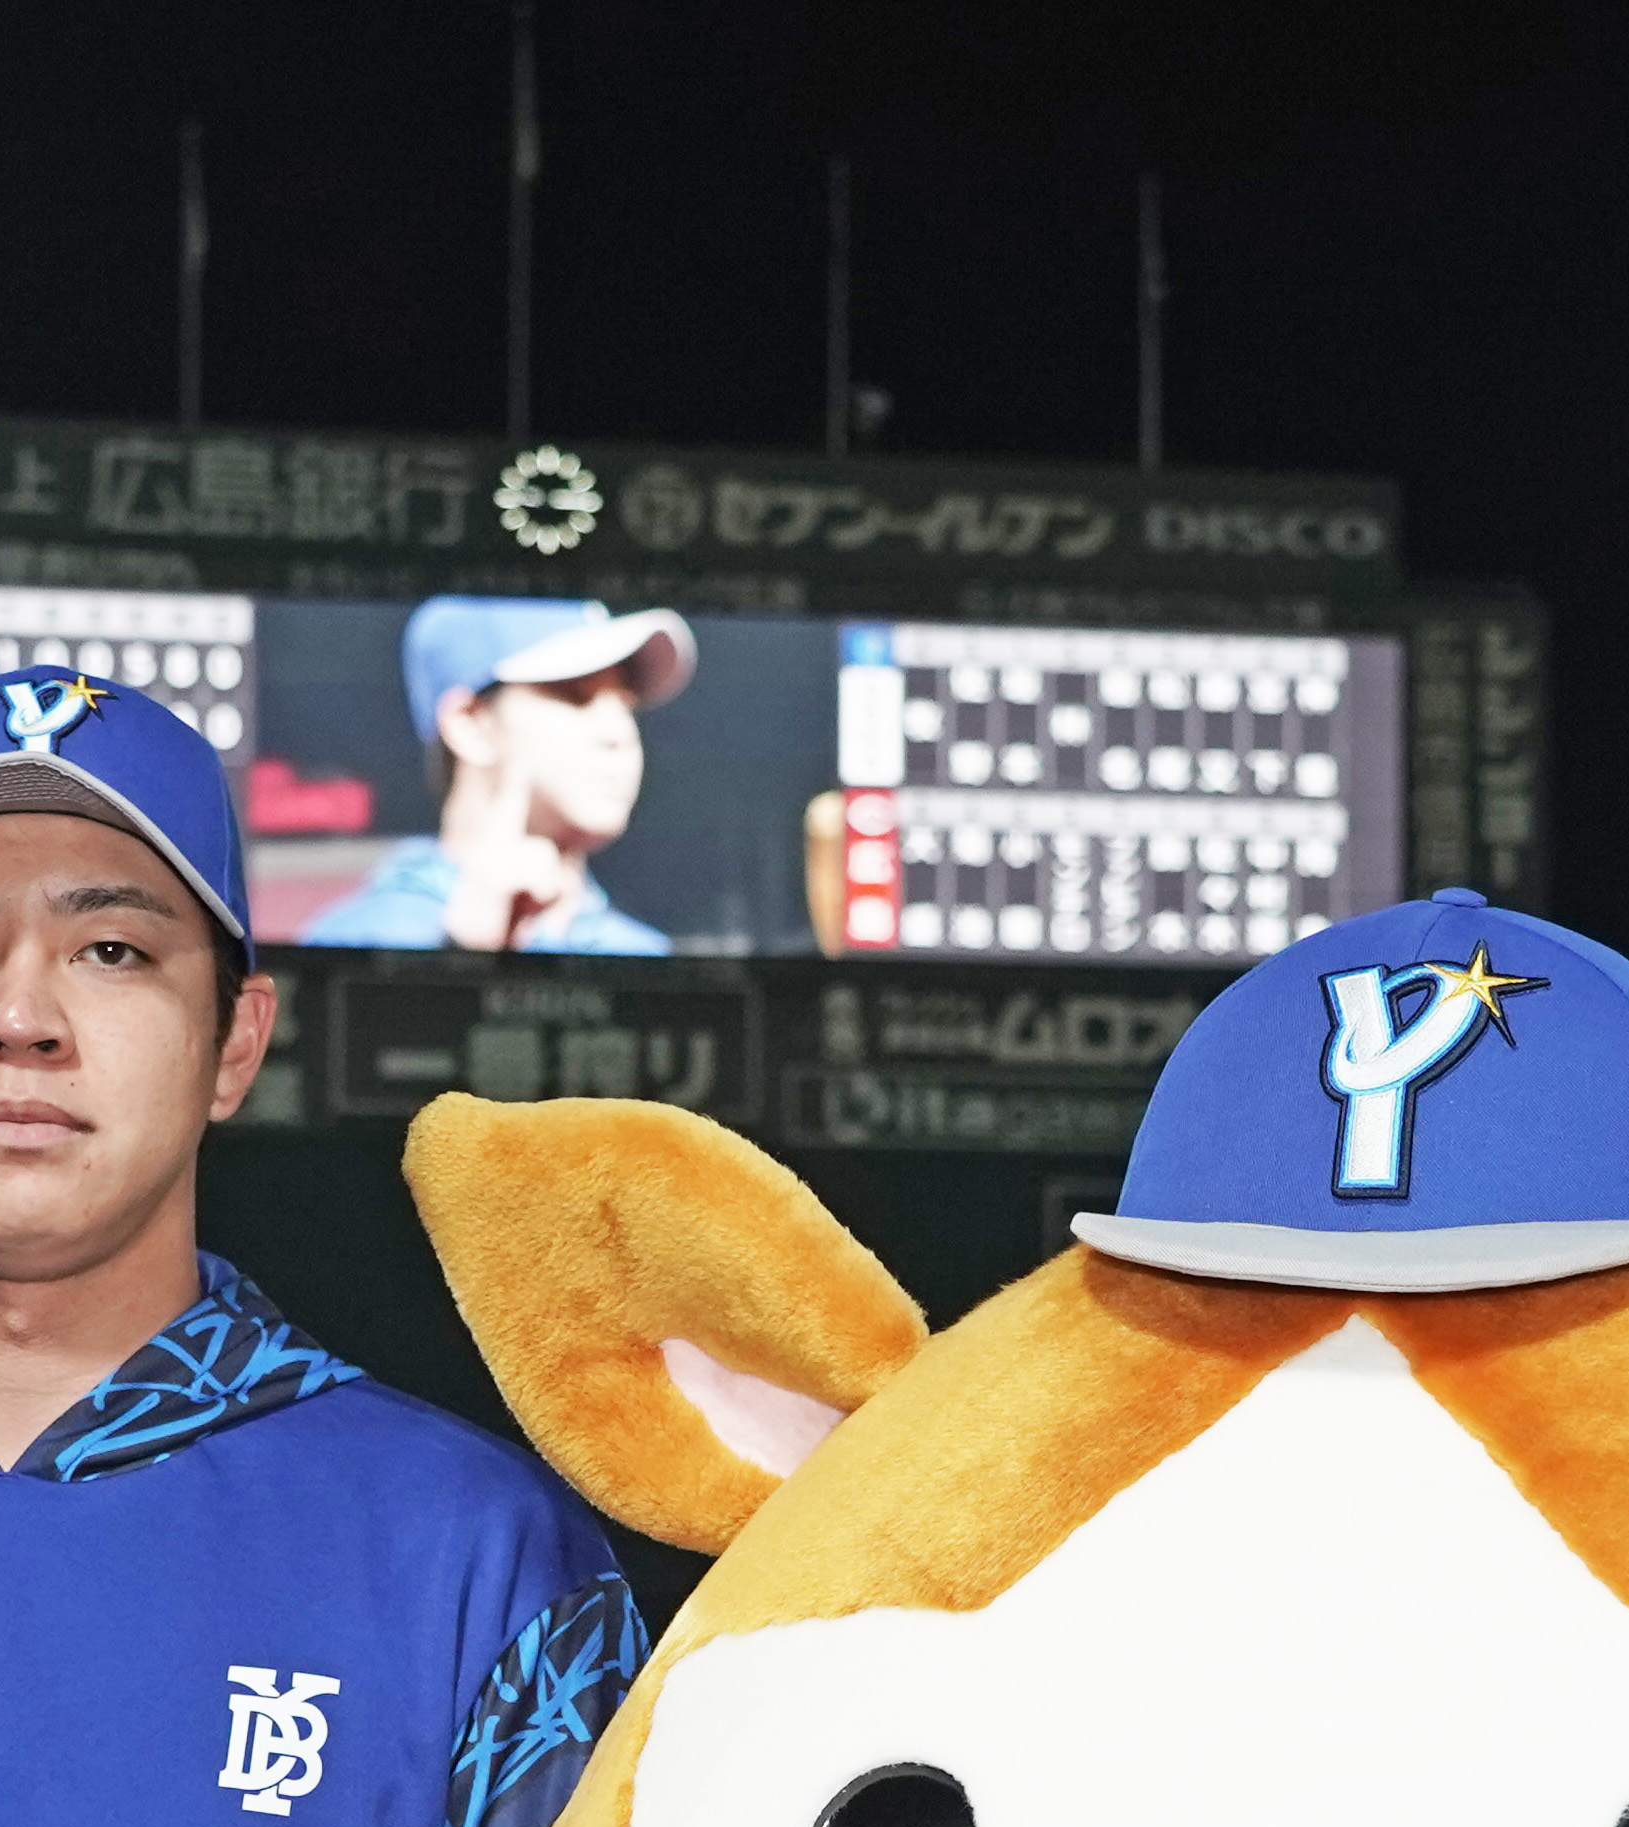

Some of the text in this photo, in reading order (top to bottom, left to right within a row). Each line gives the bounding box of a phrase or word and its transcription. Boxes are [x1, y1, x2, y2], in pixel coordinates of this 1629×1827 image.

[91, 437, 467, 549] 広島銀行
[1146, 507, 1384, 556] DISCO
[1319, 945, 1532, 1199] Y
